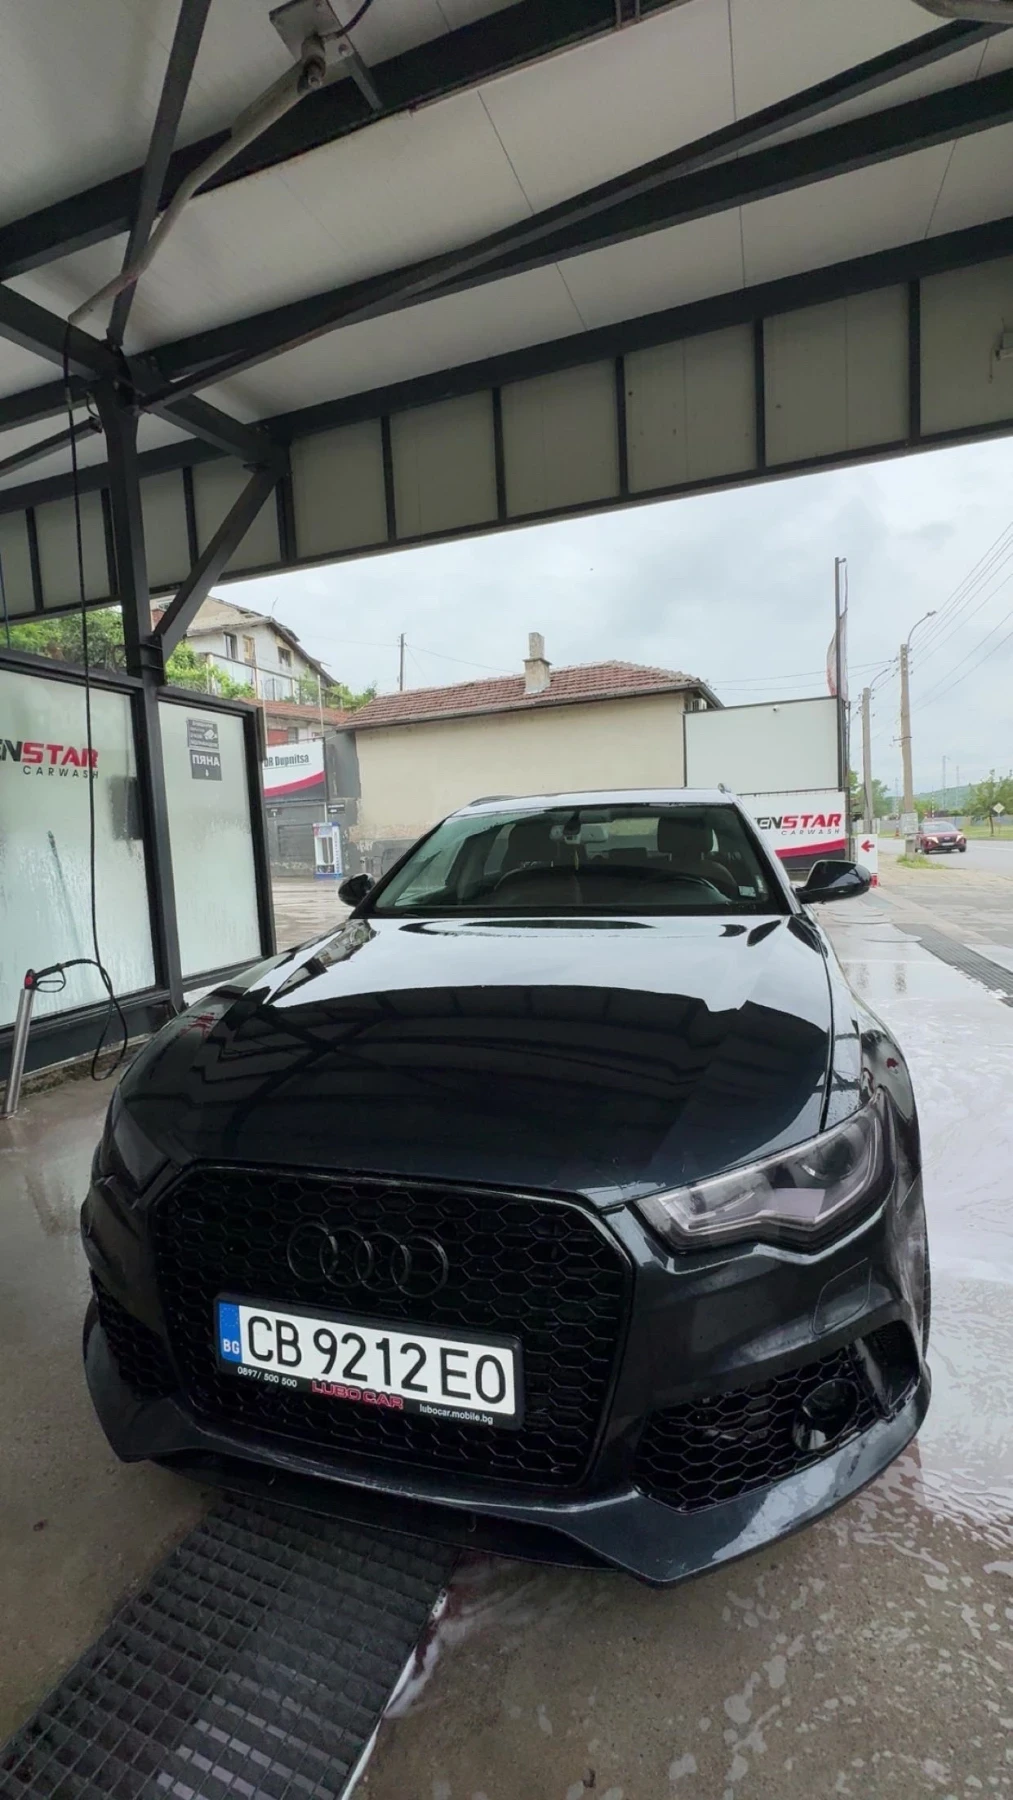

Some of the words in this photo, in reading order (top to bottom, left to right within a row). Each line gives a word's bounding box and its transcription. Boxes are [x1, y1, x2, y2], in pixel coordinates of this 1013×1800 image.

[0, 738, 99, 768] NSTAR
[192, 754, 220, 767] ПЯНА
[274, 754, 310, 768] Dupnitsa
[23, 765, 99, 779] CARWASH
[754, 813, 842, 830] ENSTAR
[223, 1339, 240, 1355] BG
[247, 1315, 303, 1368] CB
[312, 1328, 428, 1393] 9212
[263, 1372, 280, 1384] 500
[281, 1376, 298, 1388] 500
[311, 1379, 362, 1401] LUBO
[362, 1390, 404, 1410] CAR
[419, 1403, 494, 1425] lubocar.mobile.bg
